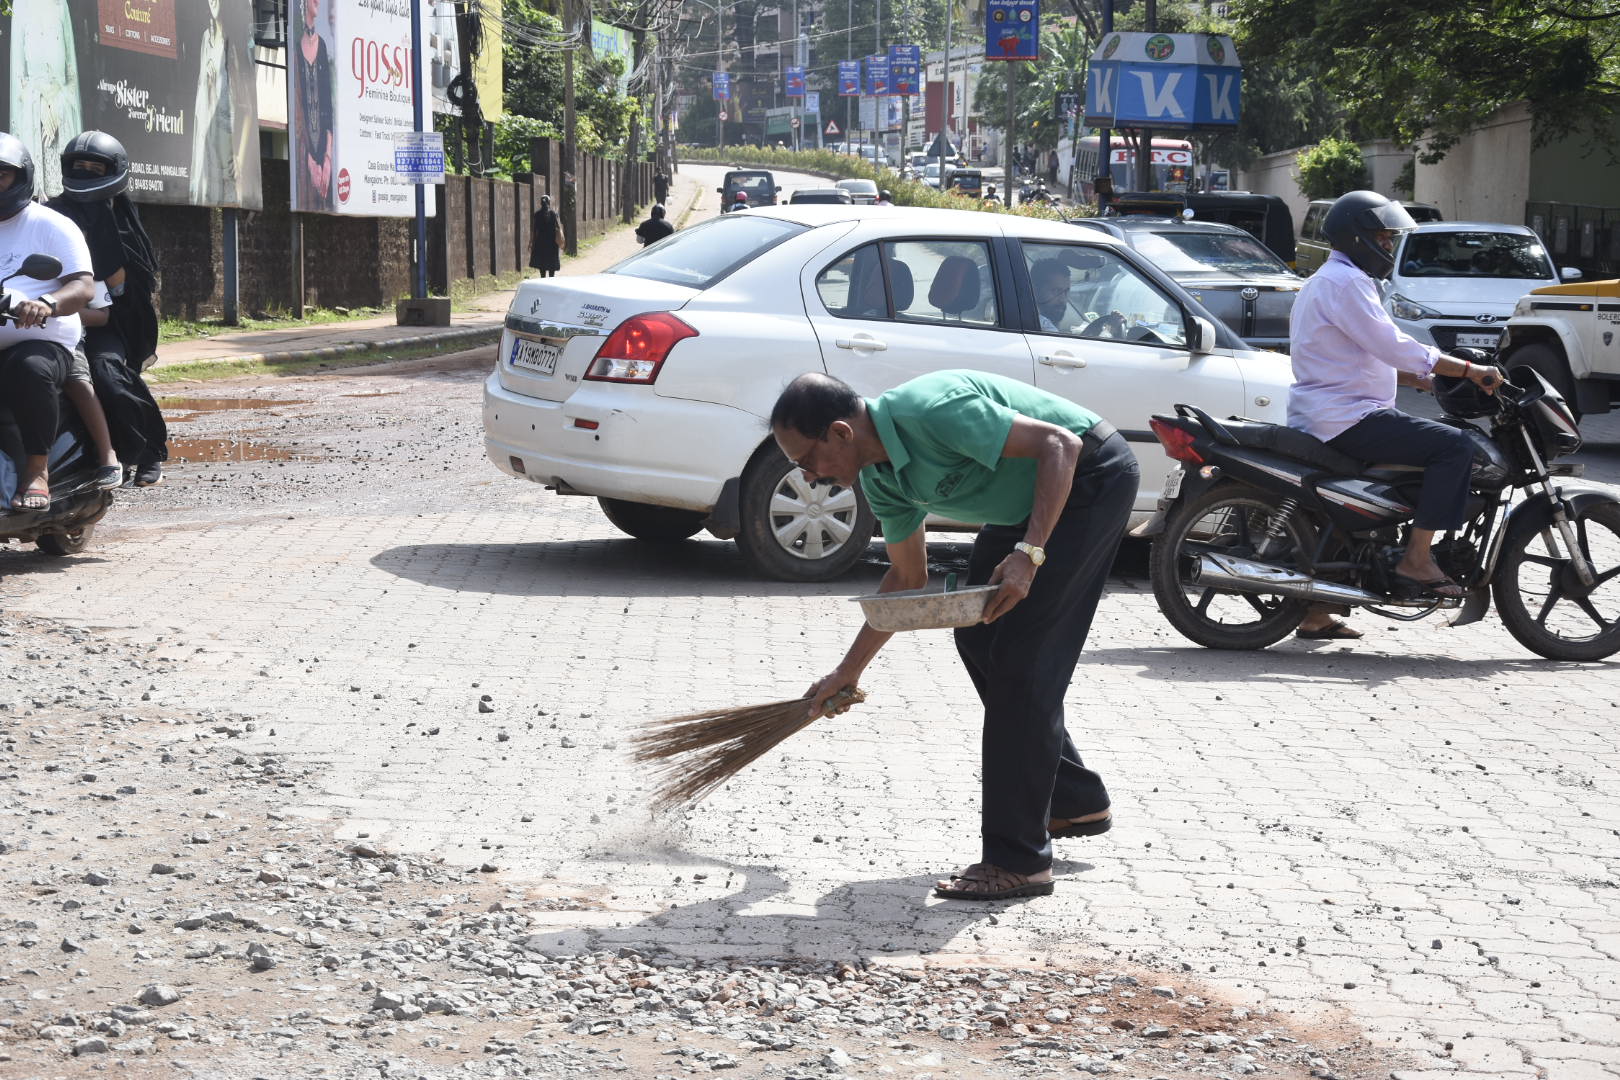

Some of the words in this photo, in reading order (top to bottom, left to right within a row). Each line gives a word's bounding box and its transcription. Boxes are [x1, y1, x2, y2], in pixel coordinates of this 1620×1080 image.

[115, 80, 149, 109] Sister
[366, 87, 389, 101] Feminine
[389, 90, 411, 104] Boutique
[145, 105, 183, 135] Friend
